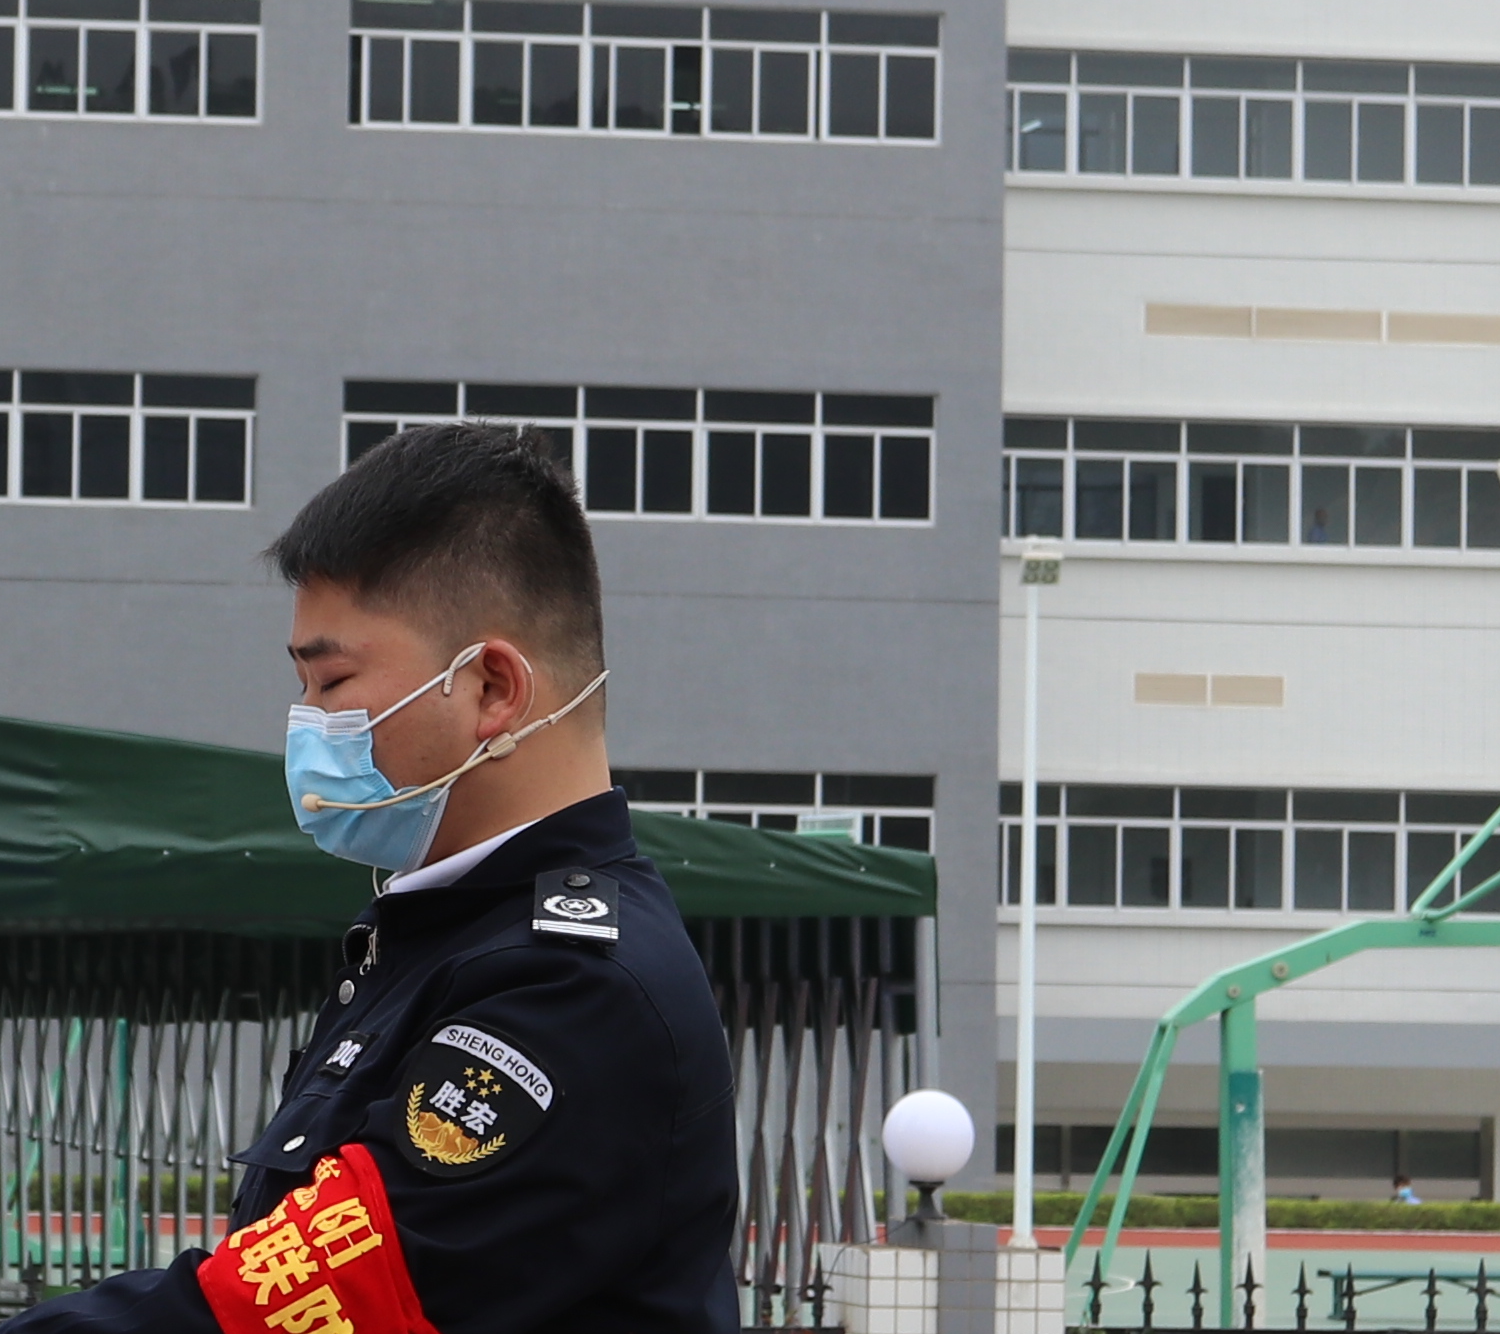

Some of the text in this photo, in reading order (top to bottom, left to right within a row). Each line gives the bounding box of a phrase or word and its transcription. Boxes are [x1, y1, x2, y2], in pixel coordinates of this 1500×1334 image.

[446, 1028, 549, 1098] SHENG HONG
[429, 1080, 498, 1135] 胜宏
